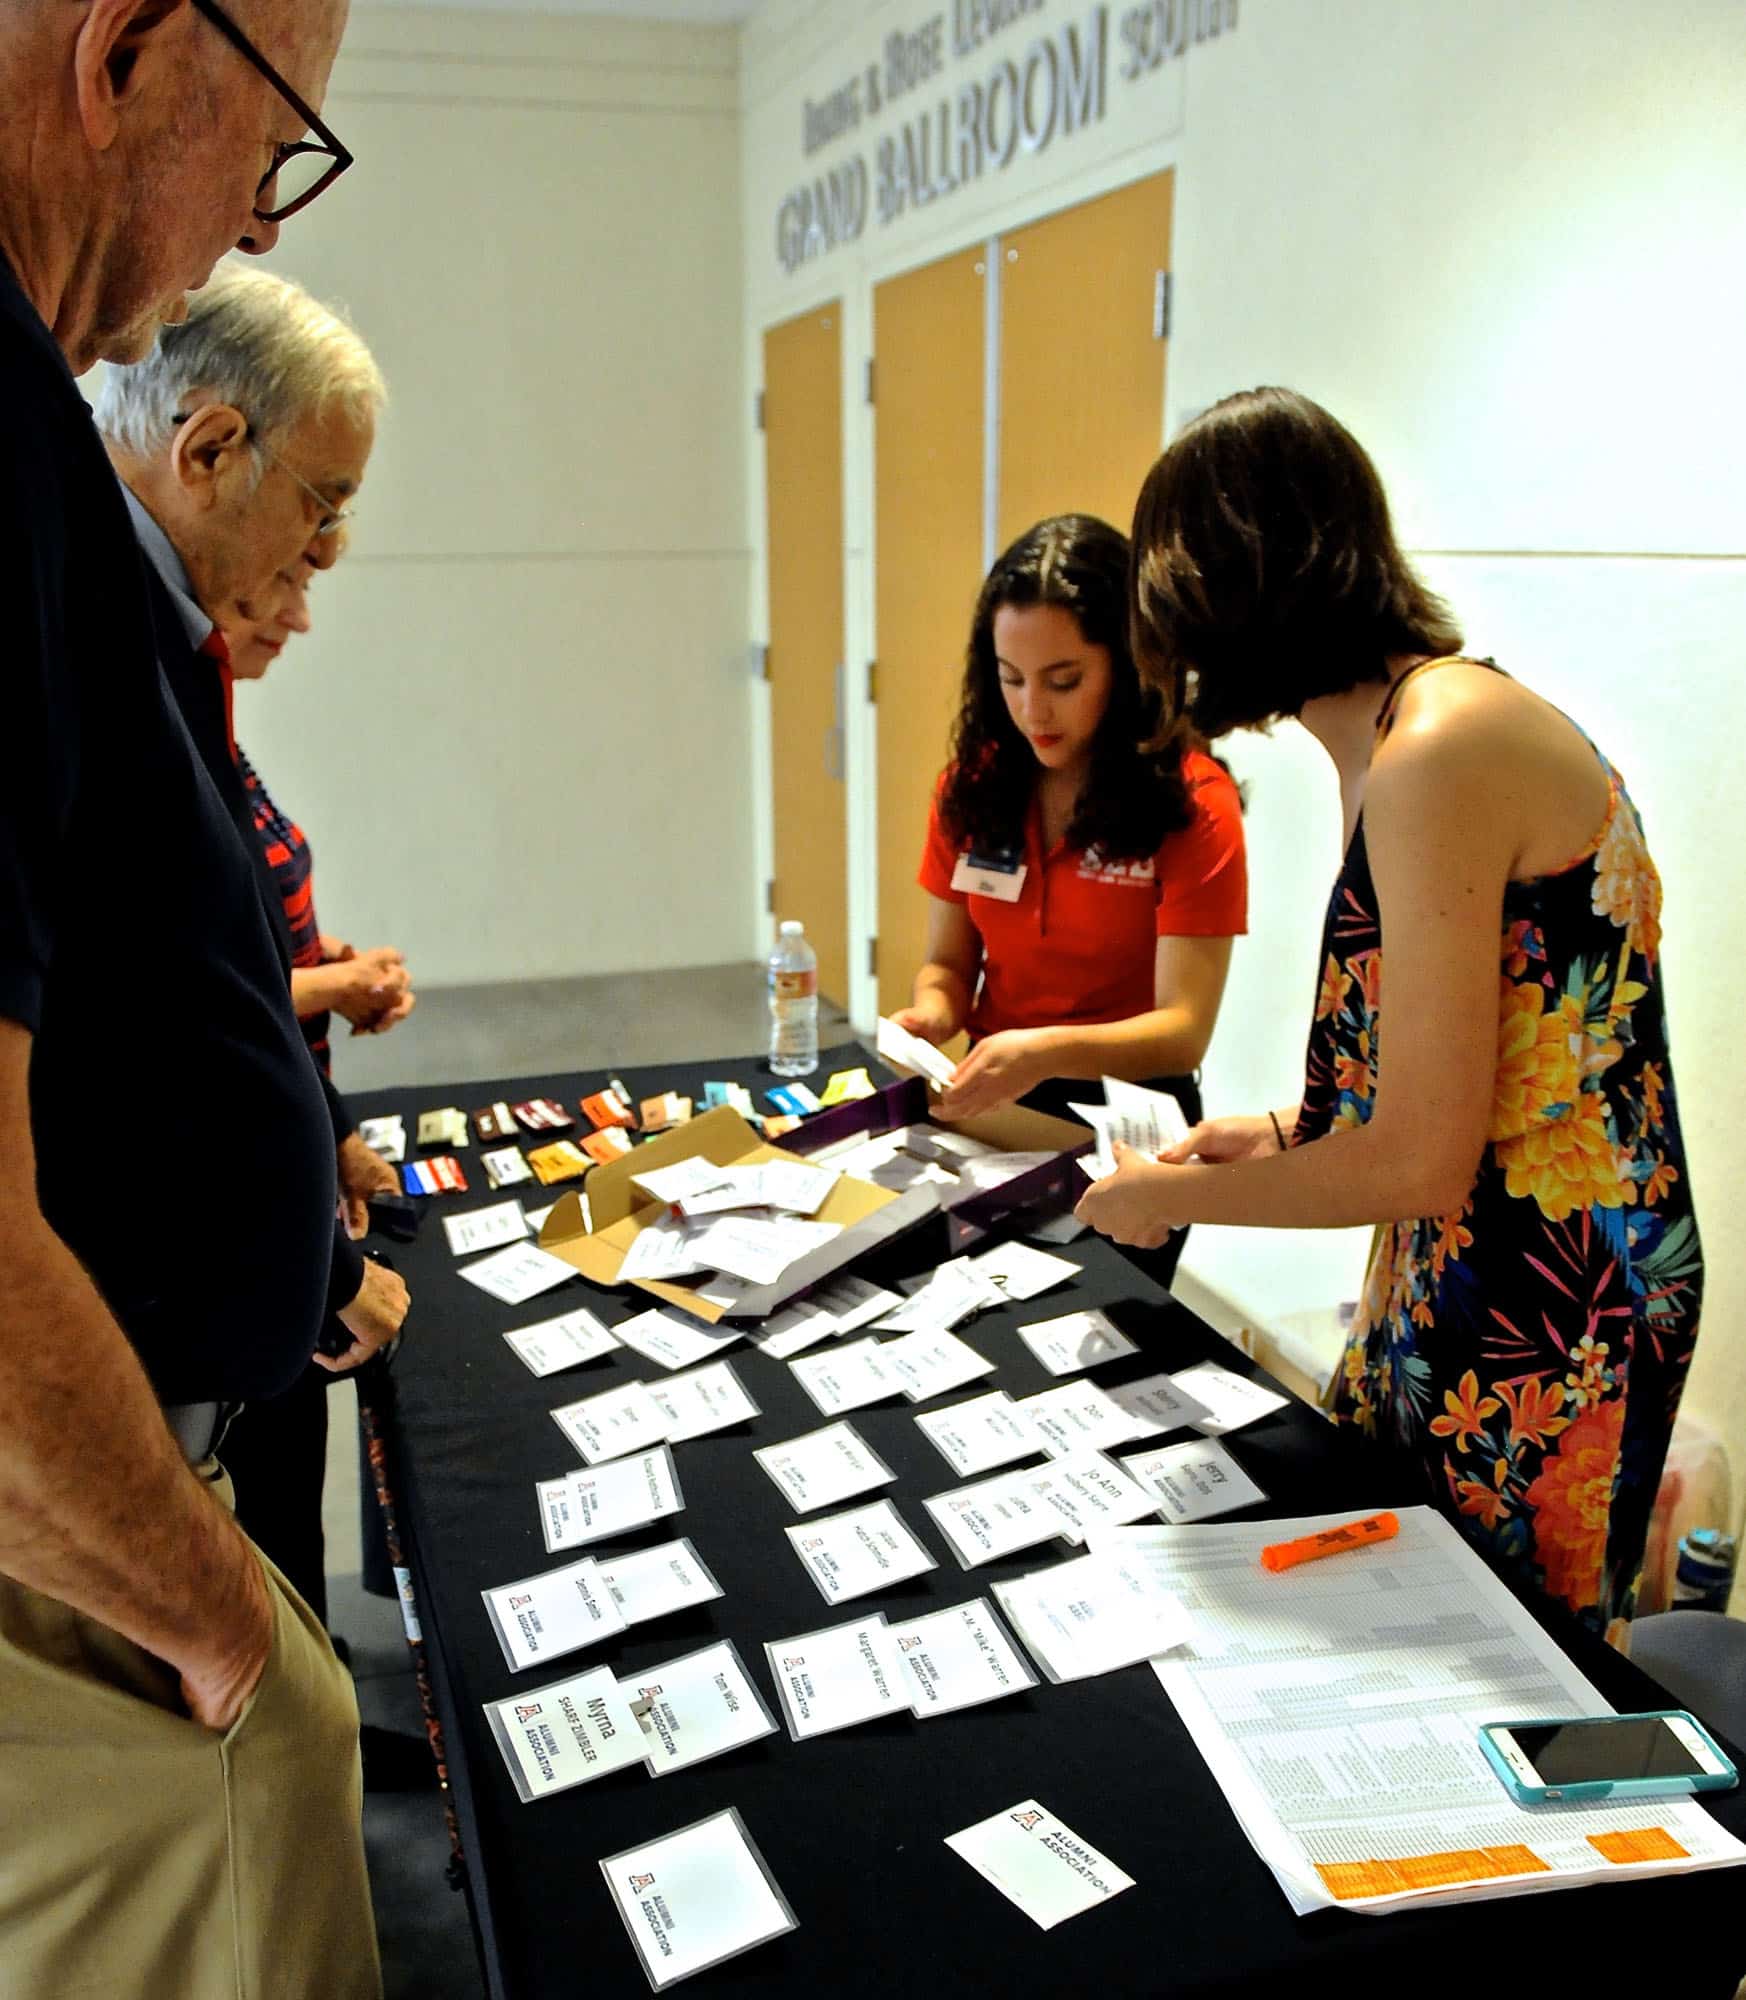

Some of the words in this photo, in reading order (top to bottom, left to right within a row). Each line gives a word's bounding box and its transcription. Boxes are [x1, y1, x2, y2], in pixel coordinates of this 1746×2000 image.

[777, 153, 868, 273] GRAND
[876, 6, 1108, 226] BALLROOM
[1097, 1479, 1122, 1499] Ann
[1199, 1461, 1228, 1483] Jerry
[575, 1578, 591, 1601] Dennis
[585, 1599, 602, 1621] Smith
[517, 1613, 539, 1652] ASSOCIATION
[857, 1632, 879, 1668] Margaret
[872, 1667, 890, 1700] Warren
[908, 1657, 938, 1701] ASSOCIATION
[987, 1656, 1009, 1686] Warren
[712, 1672, 728, 1691] Tom
[722, 1690, 740, 1712] Wise
[790, 1676, 810, 1719] ASSOCIATION
[586, 1697, 616, 1740] Myrna
[650, 1707, 678, 1755] ASSOCIATION
[660, 1702, 680, 1731] ALUMNI
[525, 1729, 556, 1781] ASSOCIATION
[538, 1724, 560, 1756] ALUMNI
[571, 1723, 597, 1763] ZIMBLER
[1039, 1837, 1112, 1894] ASSOCIATION
[1050, 1831, 1097, 1866] ALUMNI
[640, 1900, 673, 1956] ASSOCIATION
[652, 1895, 675, 1930] ALUMNI
